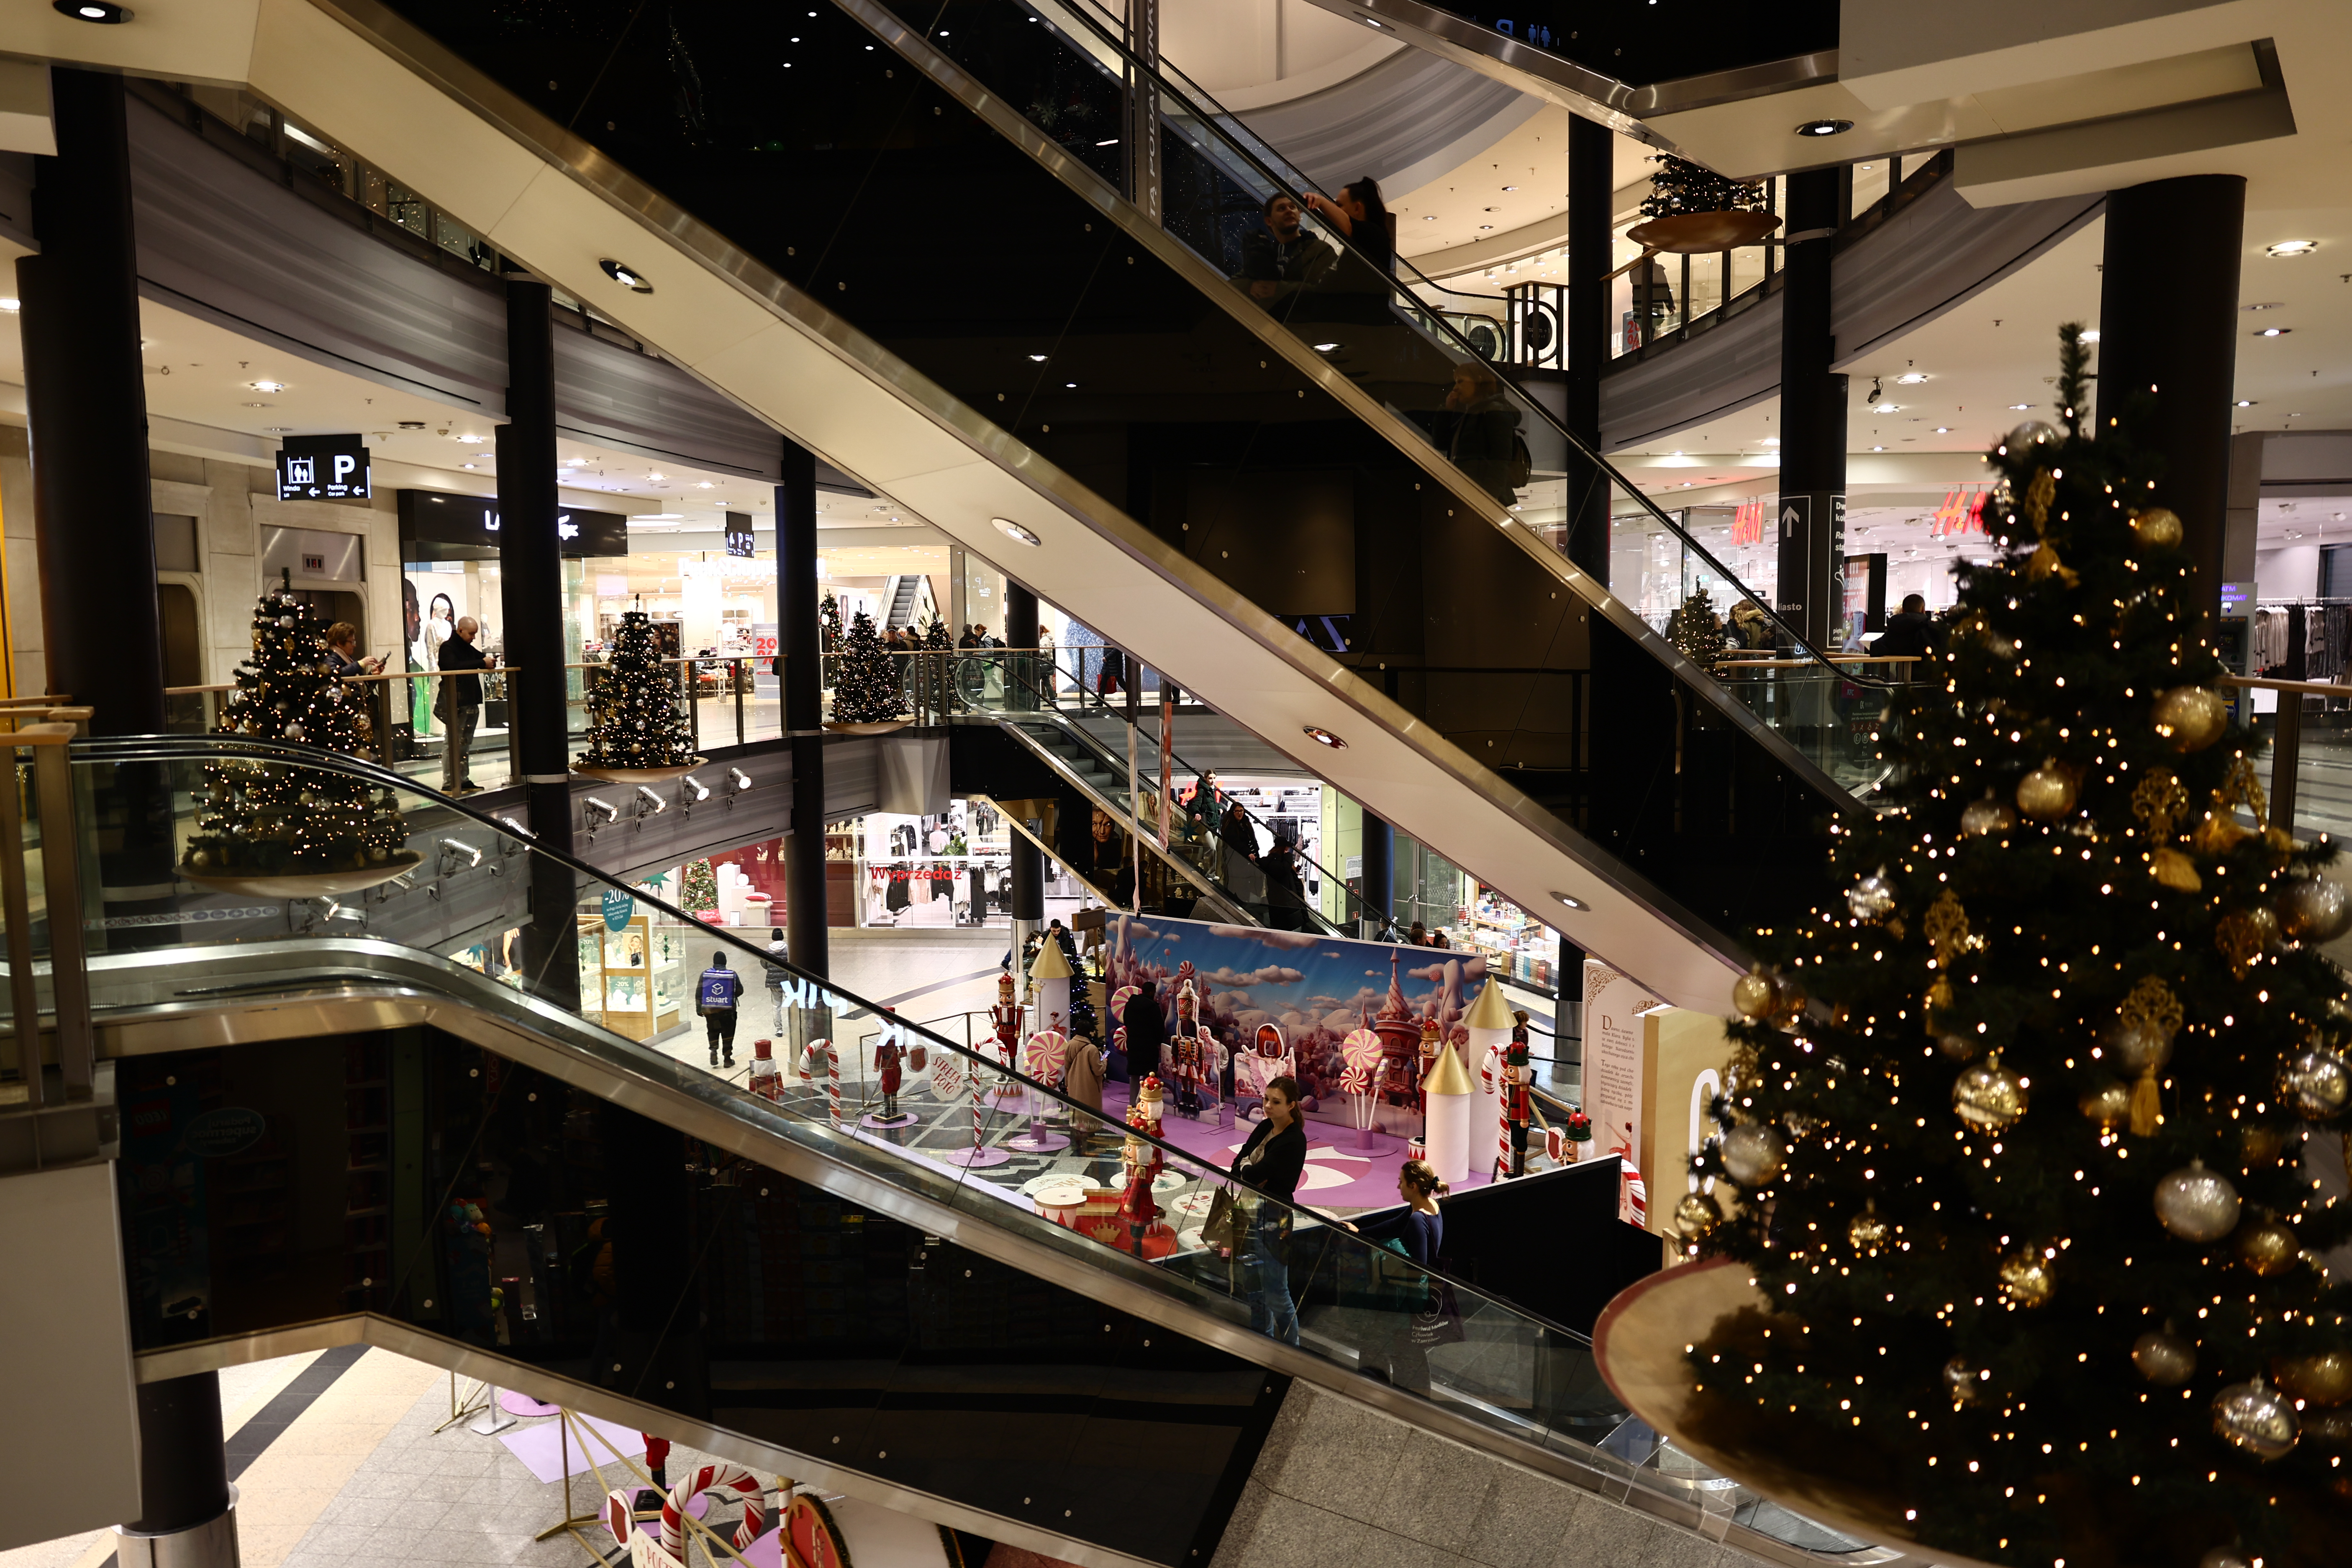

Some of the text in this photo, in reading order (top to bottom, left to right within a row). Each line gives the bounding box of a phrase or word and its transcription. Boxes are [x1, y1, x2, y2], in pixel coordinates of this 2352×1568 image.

[335, 455, 355, 483] P
[1731, 502, 1764, 546] H&M
[756, 637, 777, 649] 20
[871, 867, 962, 883] Wyprzedaż
[933, 1057, 961, 1084] STREFA
[933, 1073, 955, 1094] FOTO
[1431, 1320, 1449, 1330] Mediów
